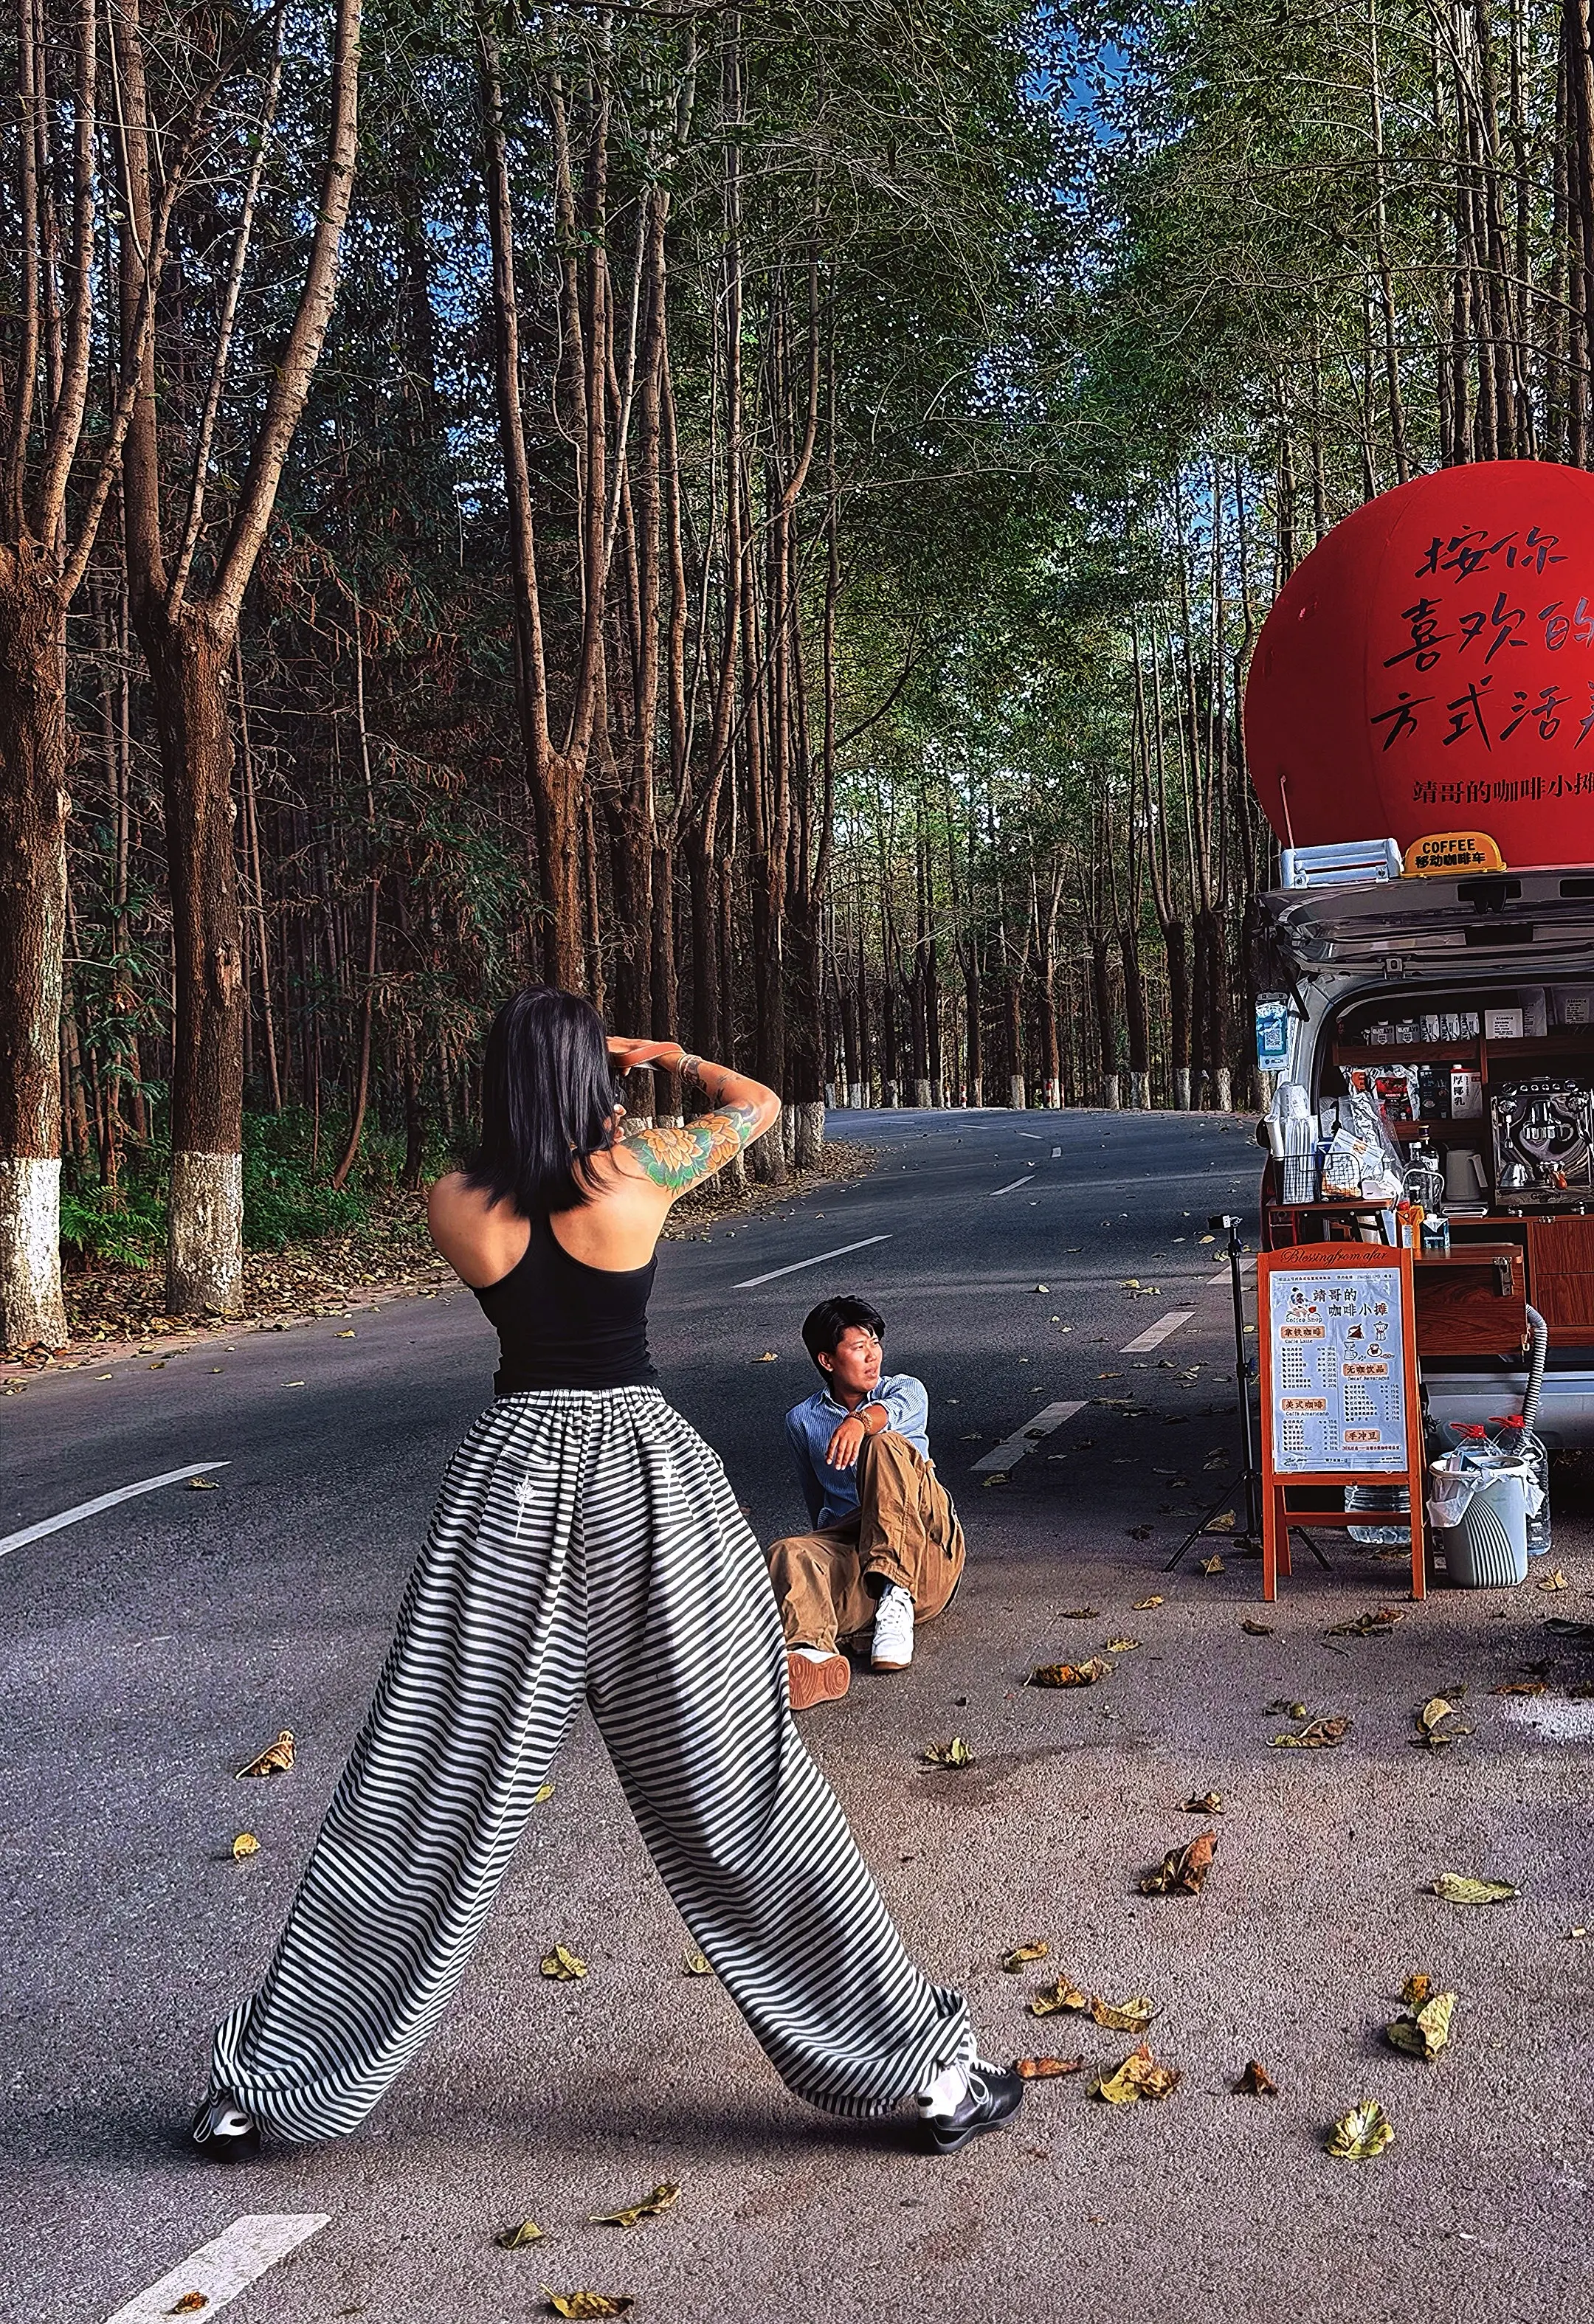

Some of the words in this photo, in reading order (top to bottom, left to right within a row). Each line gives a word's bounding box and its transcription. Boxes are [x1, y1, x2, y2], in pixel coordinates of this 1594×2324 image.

[1415, 525, 1568, 584] 按你
[1383, 592, 1594, 672] 喜欢的
[1422, 838, 1475, 854] COFFEE
[1415, 851, 1486, 868] 移动咖啡车
[1363, 1248, 1387, 1264] afar
[1313, 1288, 1357, 1302] 靖哥的
[1328, 1303, 1388, 1317] 咖啡小摊
[1285, 1327, 1321, 1337] 拿铁咖啡
[1347, 1365, 1384, 1374] 无咖饮品
[1348, 1431, 1377, 1440] 手冲豆
